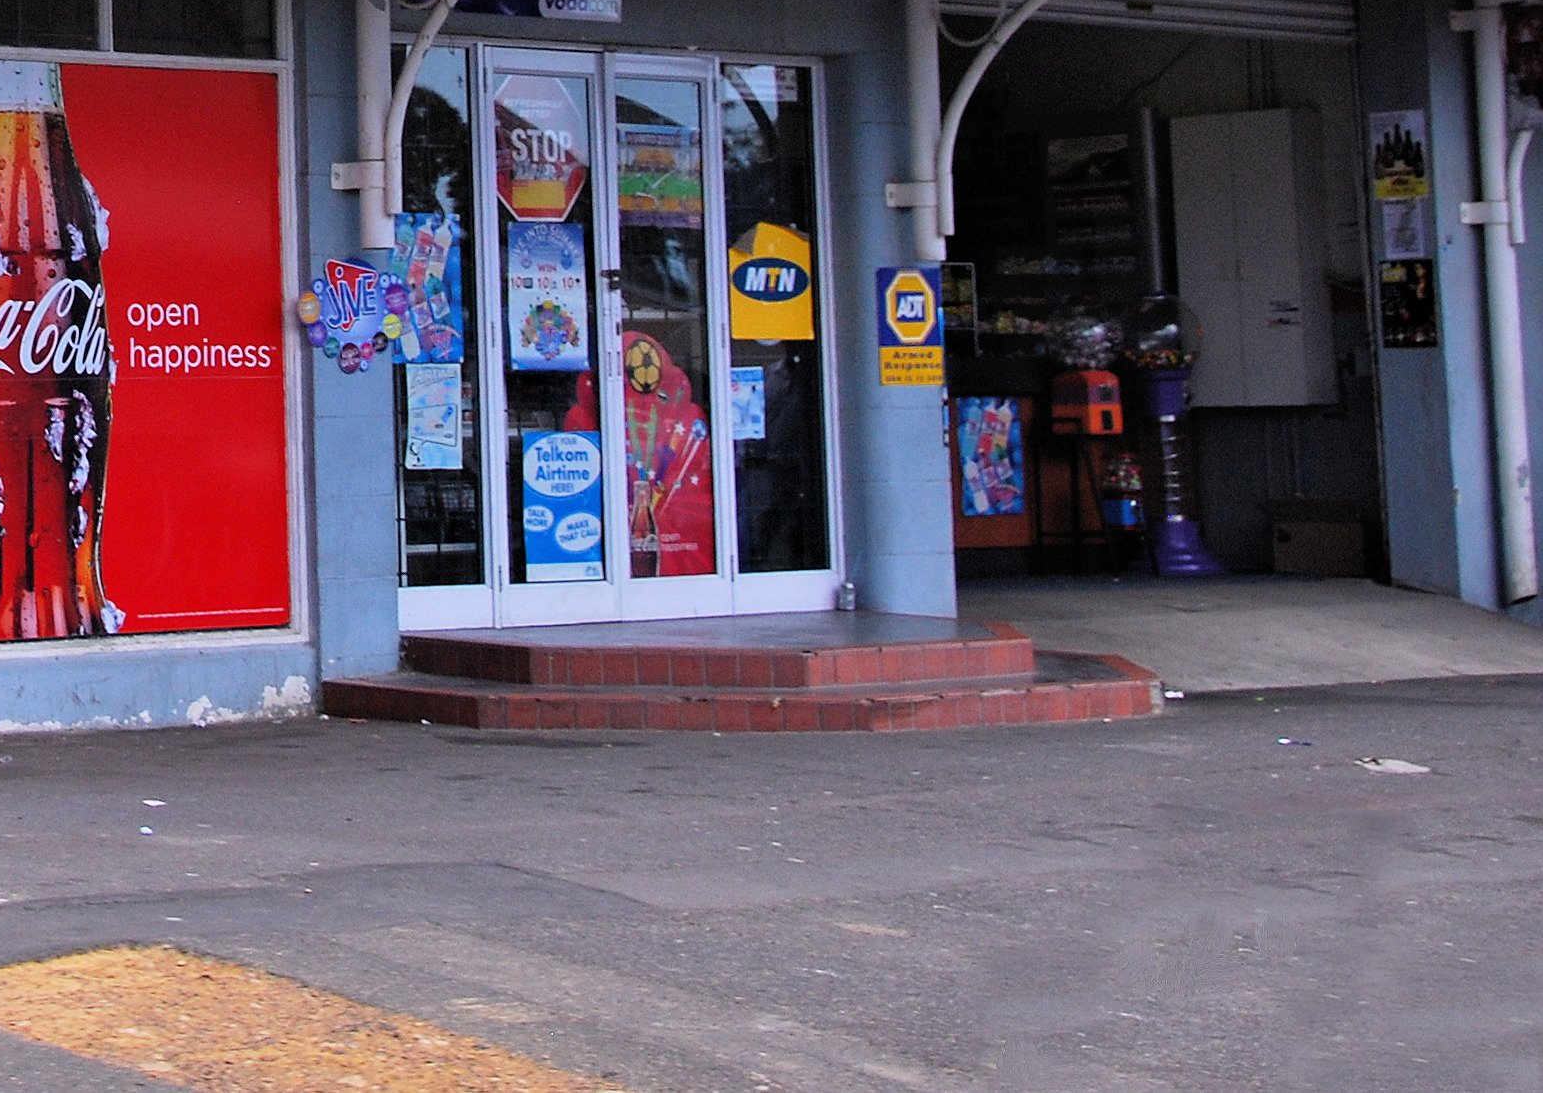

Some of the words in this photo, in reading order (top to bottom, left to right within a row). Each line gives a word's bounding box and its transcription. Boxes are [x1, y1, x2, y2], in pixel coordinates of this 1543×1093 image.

[510, 127, 572, 163] STOP
[744, 266, 797, 293] MTN
[127, 302, 199, 332] open
[896, 294, 925, 318] ADT
[129, 338, 272, 373] happiness
[535, 446, 589, 463] Telkom
[535, 465, 590, 481] Airtime
